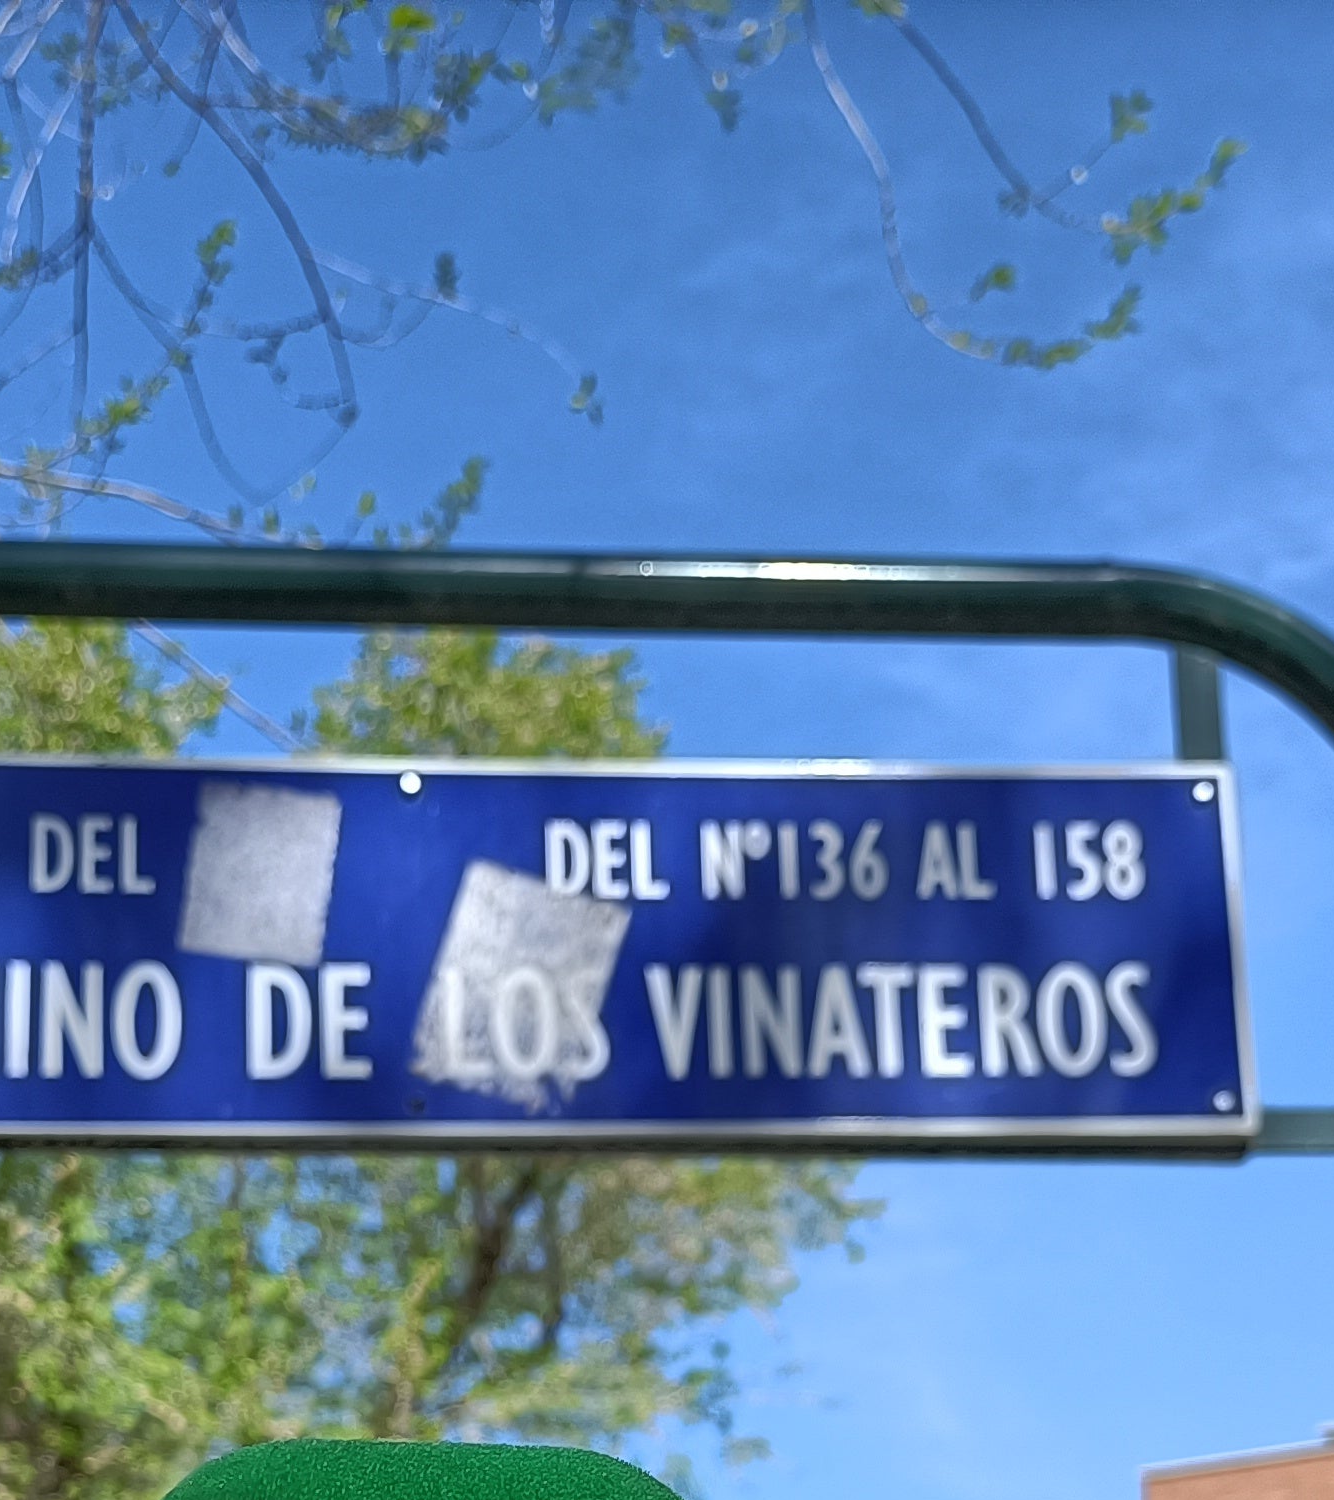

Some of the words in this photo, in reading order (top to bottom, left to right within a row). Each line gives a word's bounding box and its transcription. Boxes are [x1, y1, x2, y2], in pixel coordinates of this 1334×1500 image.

[28, 813, 157, 895] DEL
[542, 818, 671, 901] DEL
[915, 820, 997, 902] AL
[1031, 820, 1148, 902] 158
[244, 960, 374, 1082] DE
[439, 964, 612, 1082] LOS
[643, 962, 1160, 1081] VINATEROS
